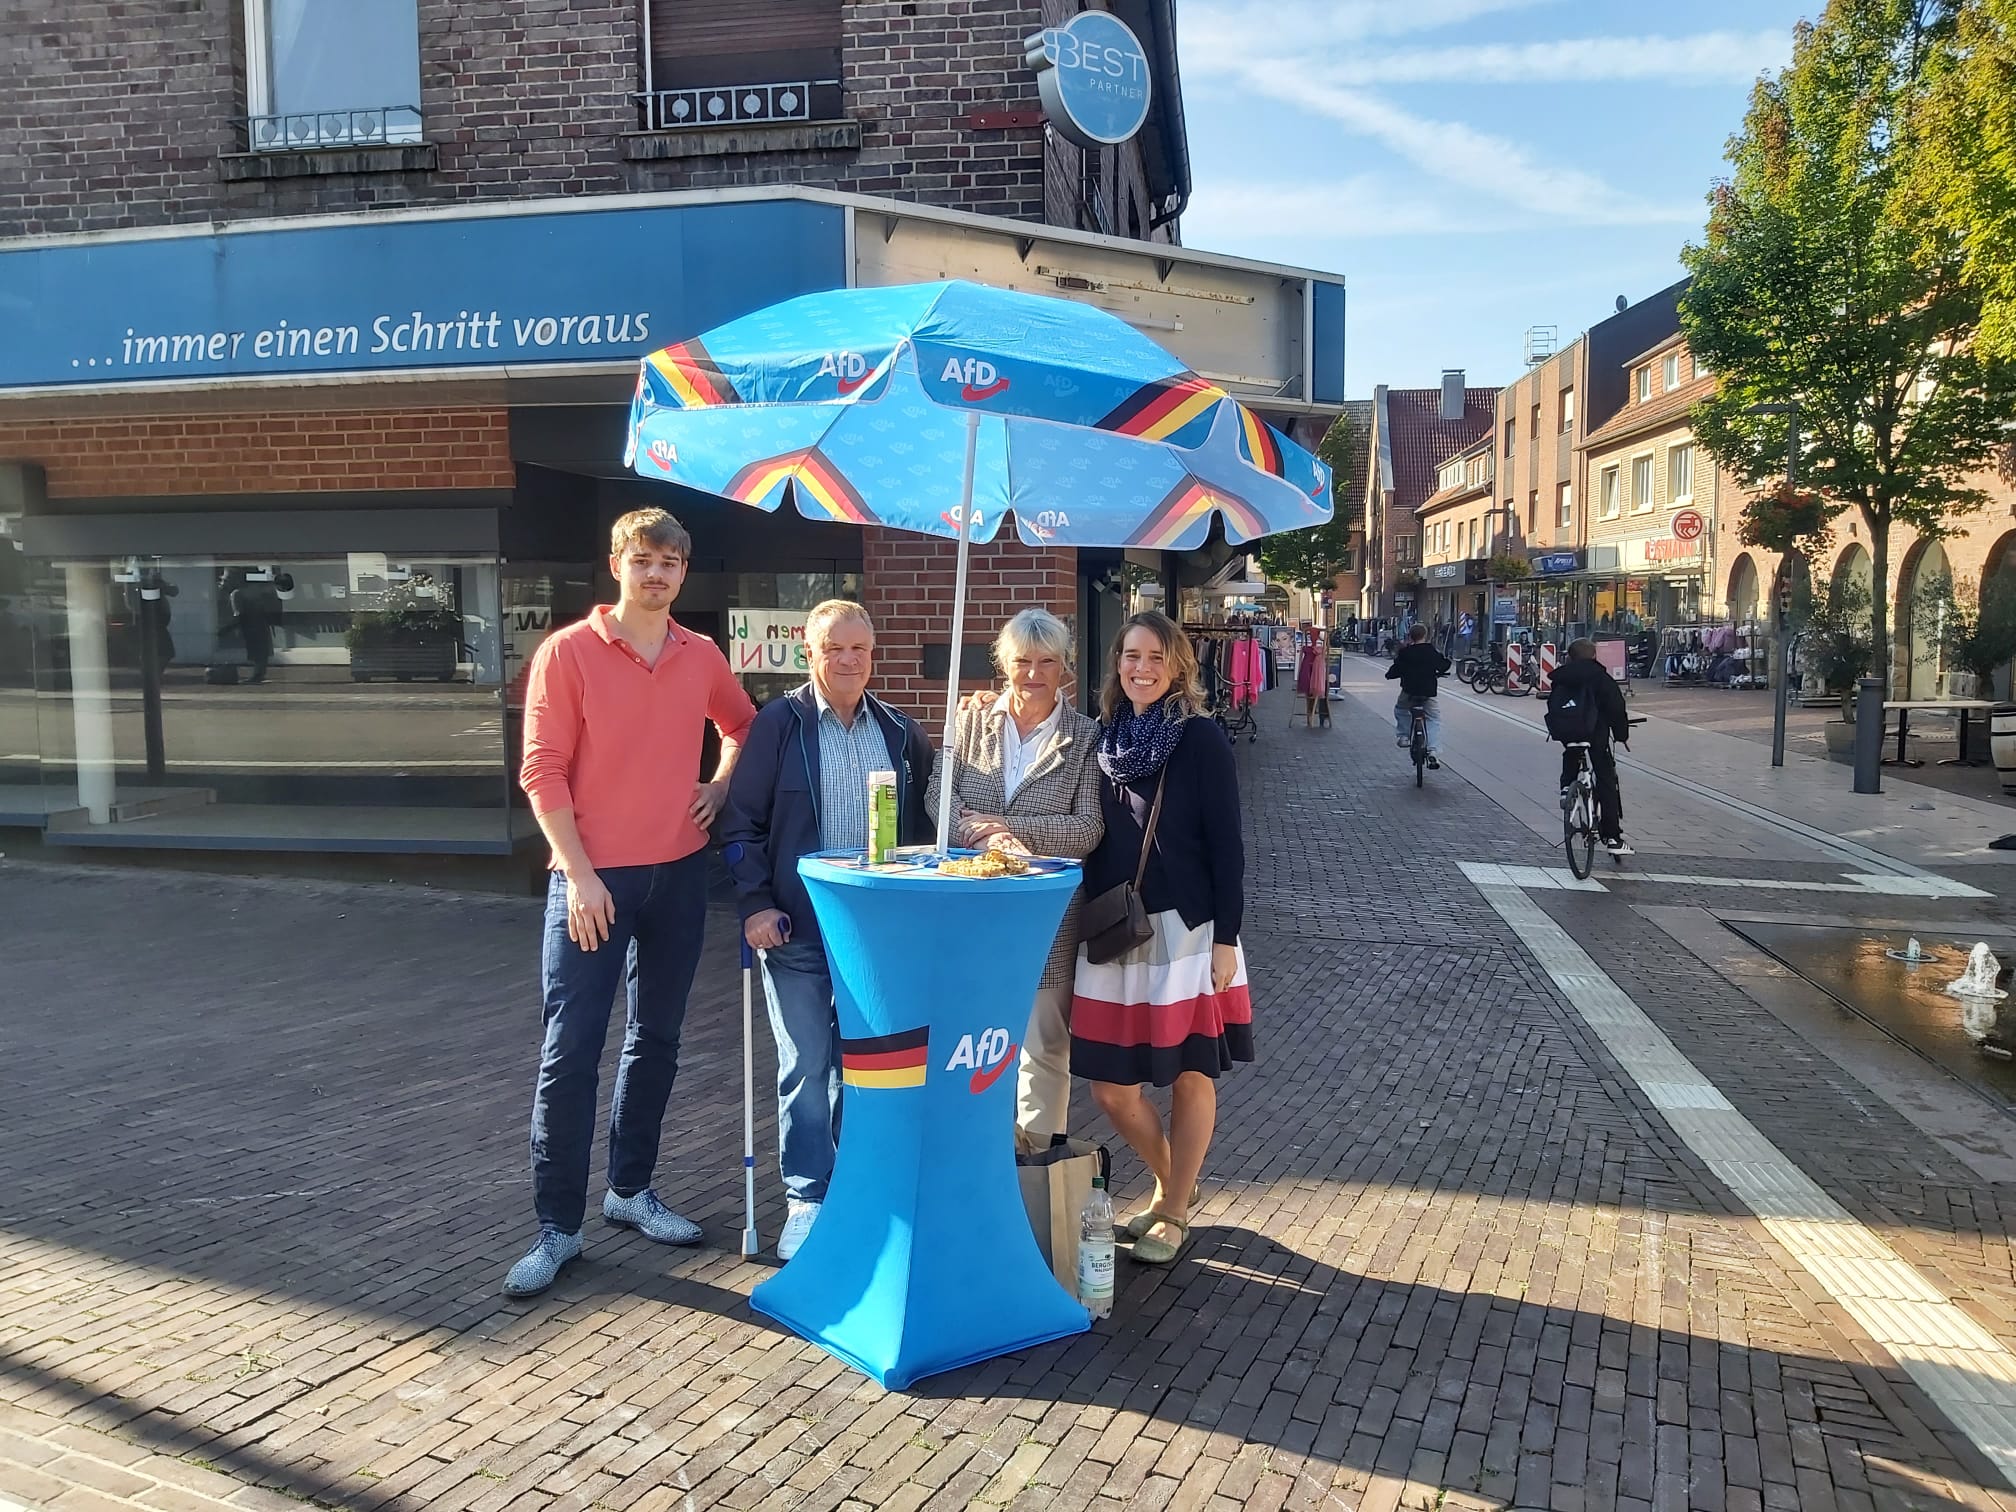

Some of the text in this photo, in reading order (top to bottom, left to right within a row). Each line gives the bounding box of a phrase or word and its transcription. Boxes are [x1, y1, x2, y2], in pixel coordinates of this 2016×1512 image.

[1043, 29, 1144, 82] BEST
[1090, 78, 1143, 100] PARTNER
[254, 319, 359, 358] einen
[371, 310, 502, 353] Schritt
[513, 312, 650, 347] voraus
[818, 351, 866, 378] AfD
[940, 357, 998, 386] AfD
[944, 1027, 1009, 1071] AfD
